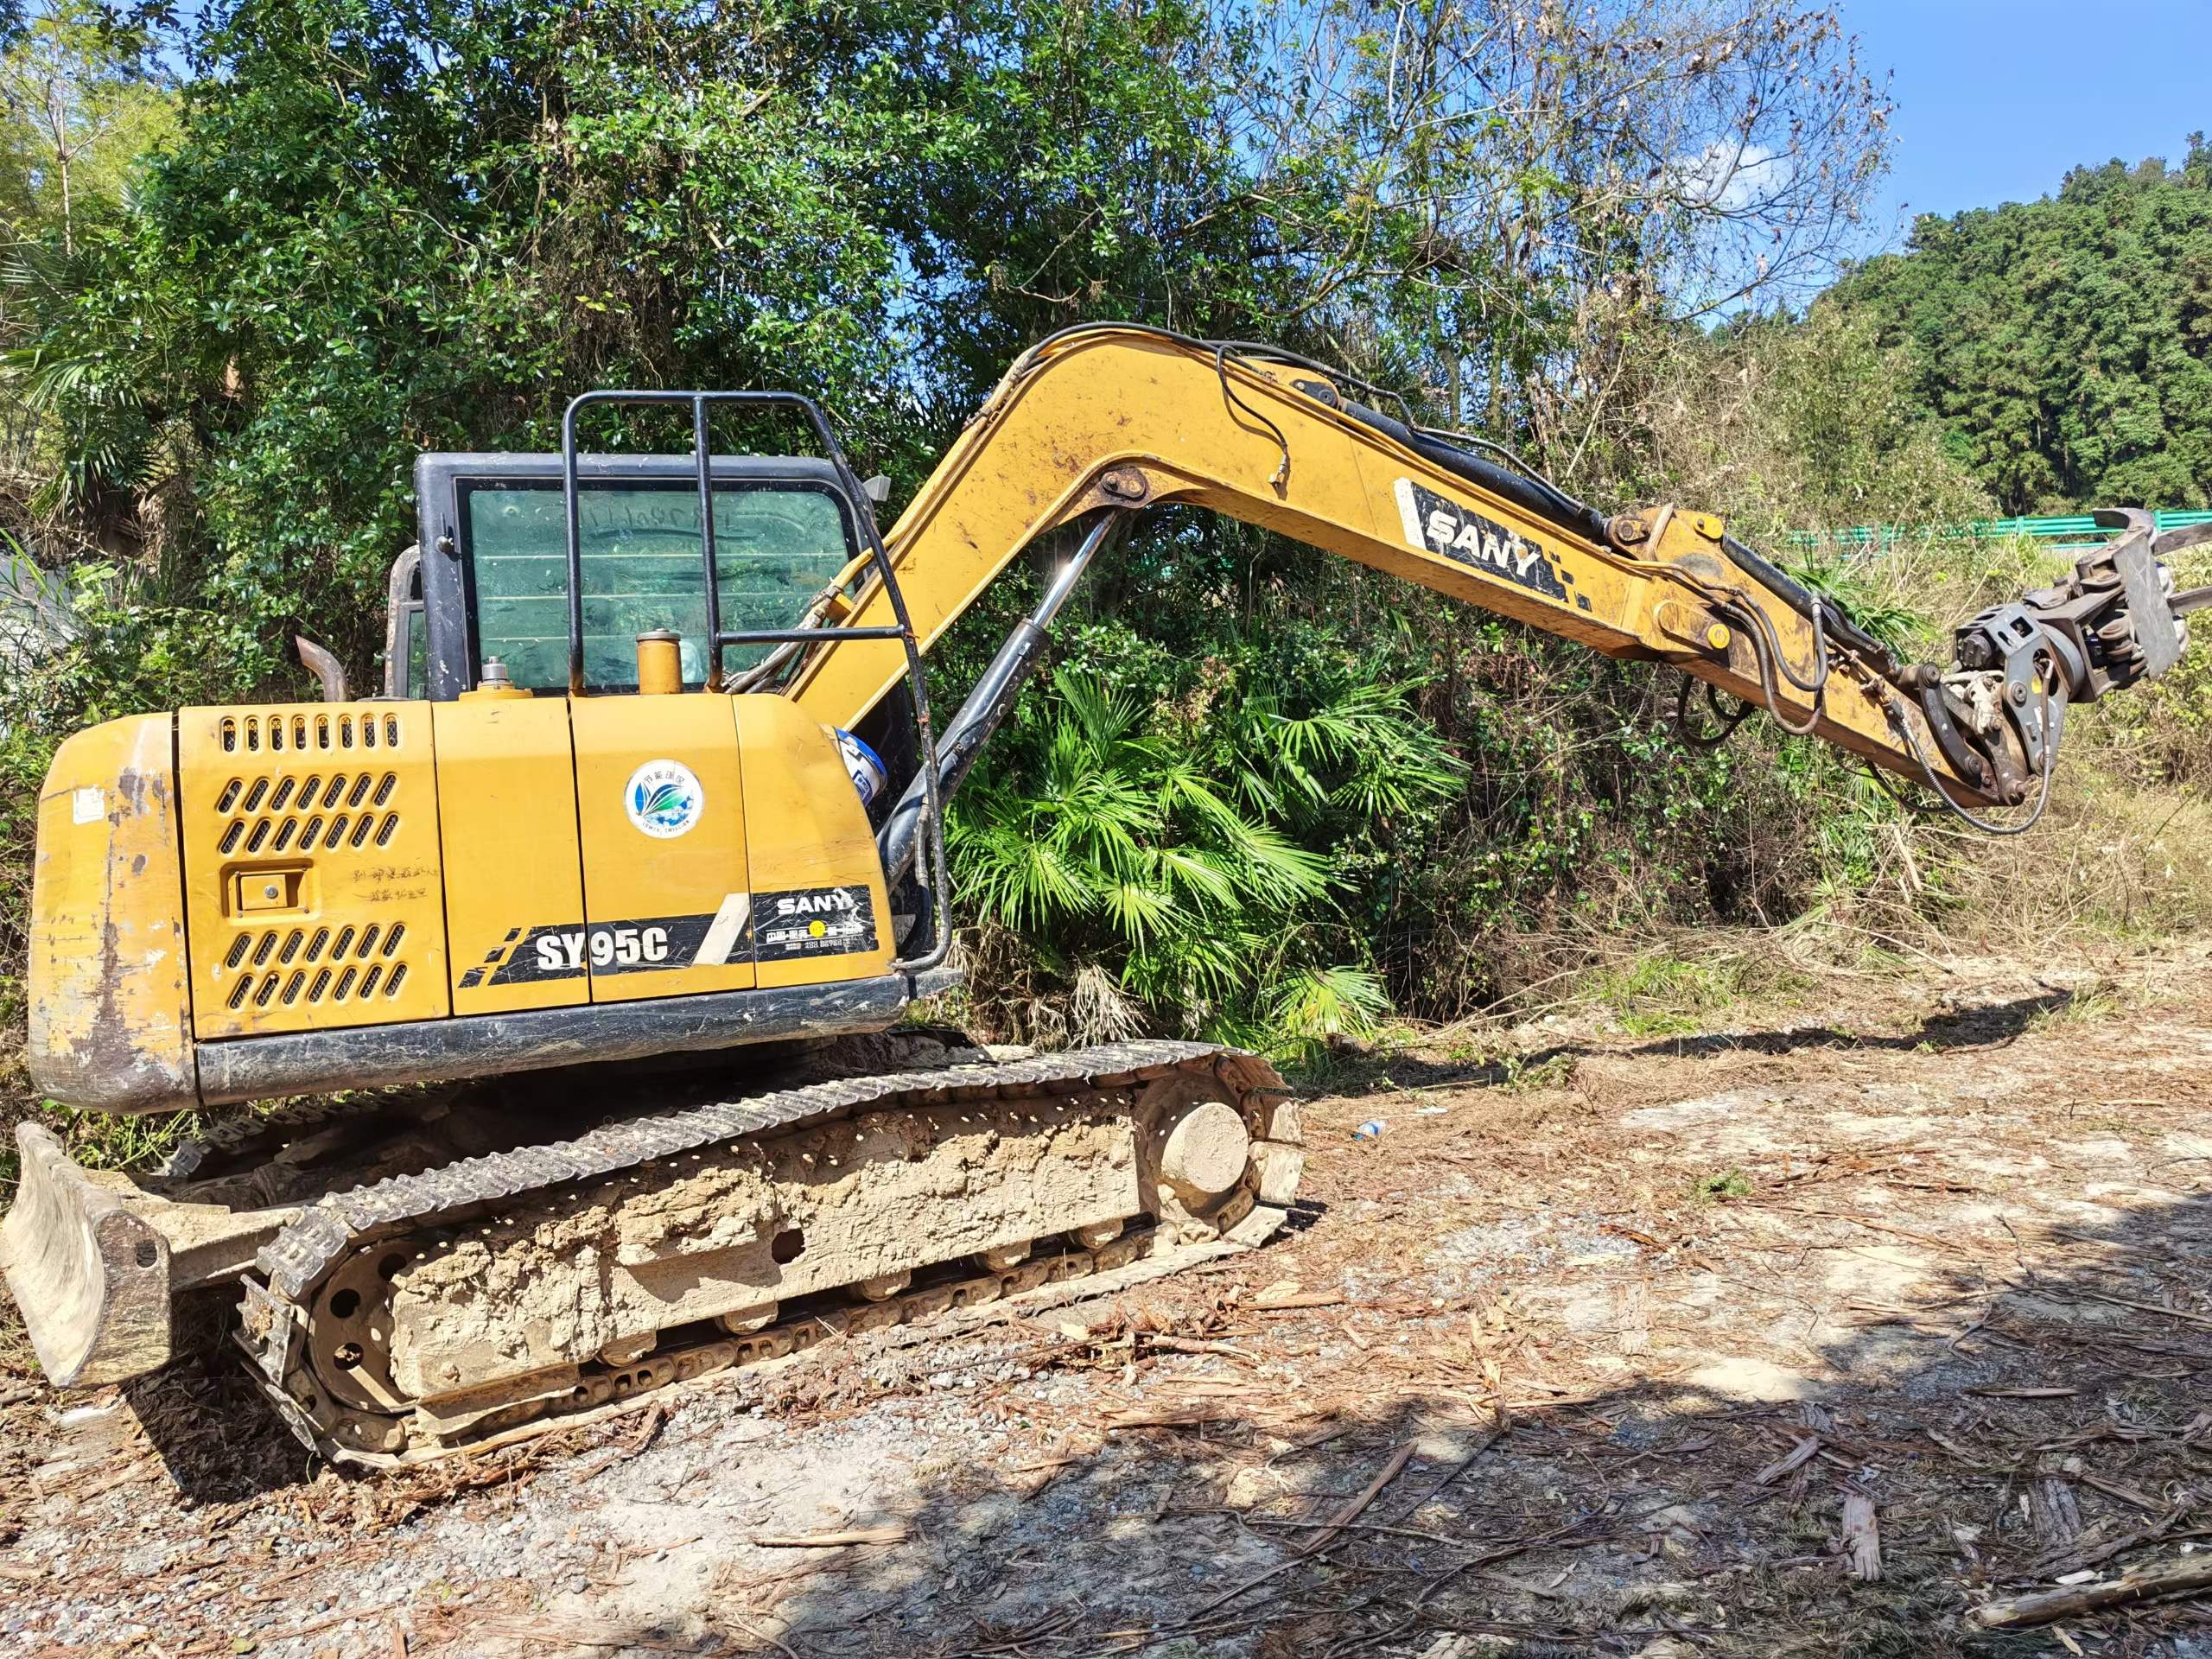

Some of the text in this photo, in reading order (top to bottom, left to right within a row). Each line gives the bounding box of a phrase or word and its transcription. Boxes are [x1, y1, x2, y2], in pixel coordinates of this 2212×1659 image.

[1426, 509, 1541, 578] SANY
[777, 894, 849, 916] SANY
[535, 927, 669, 970] SY95C
